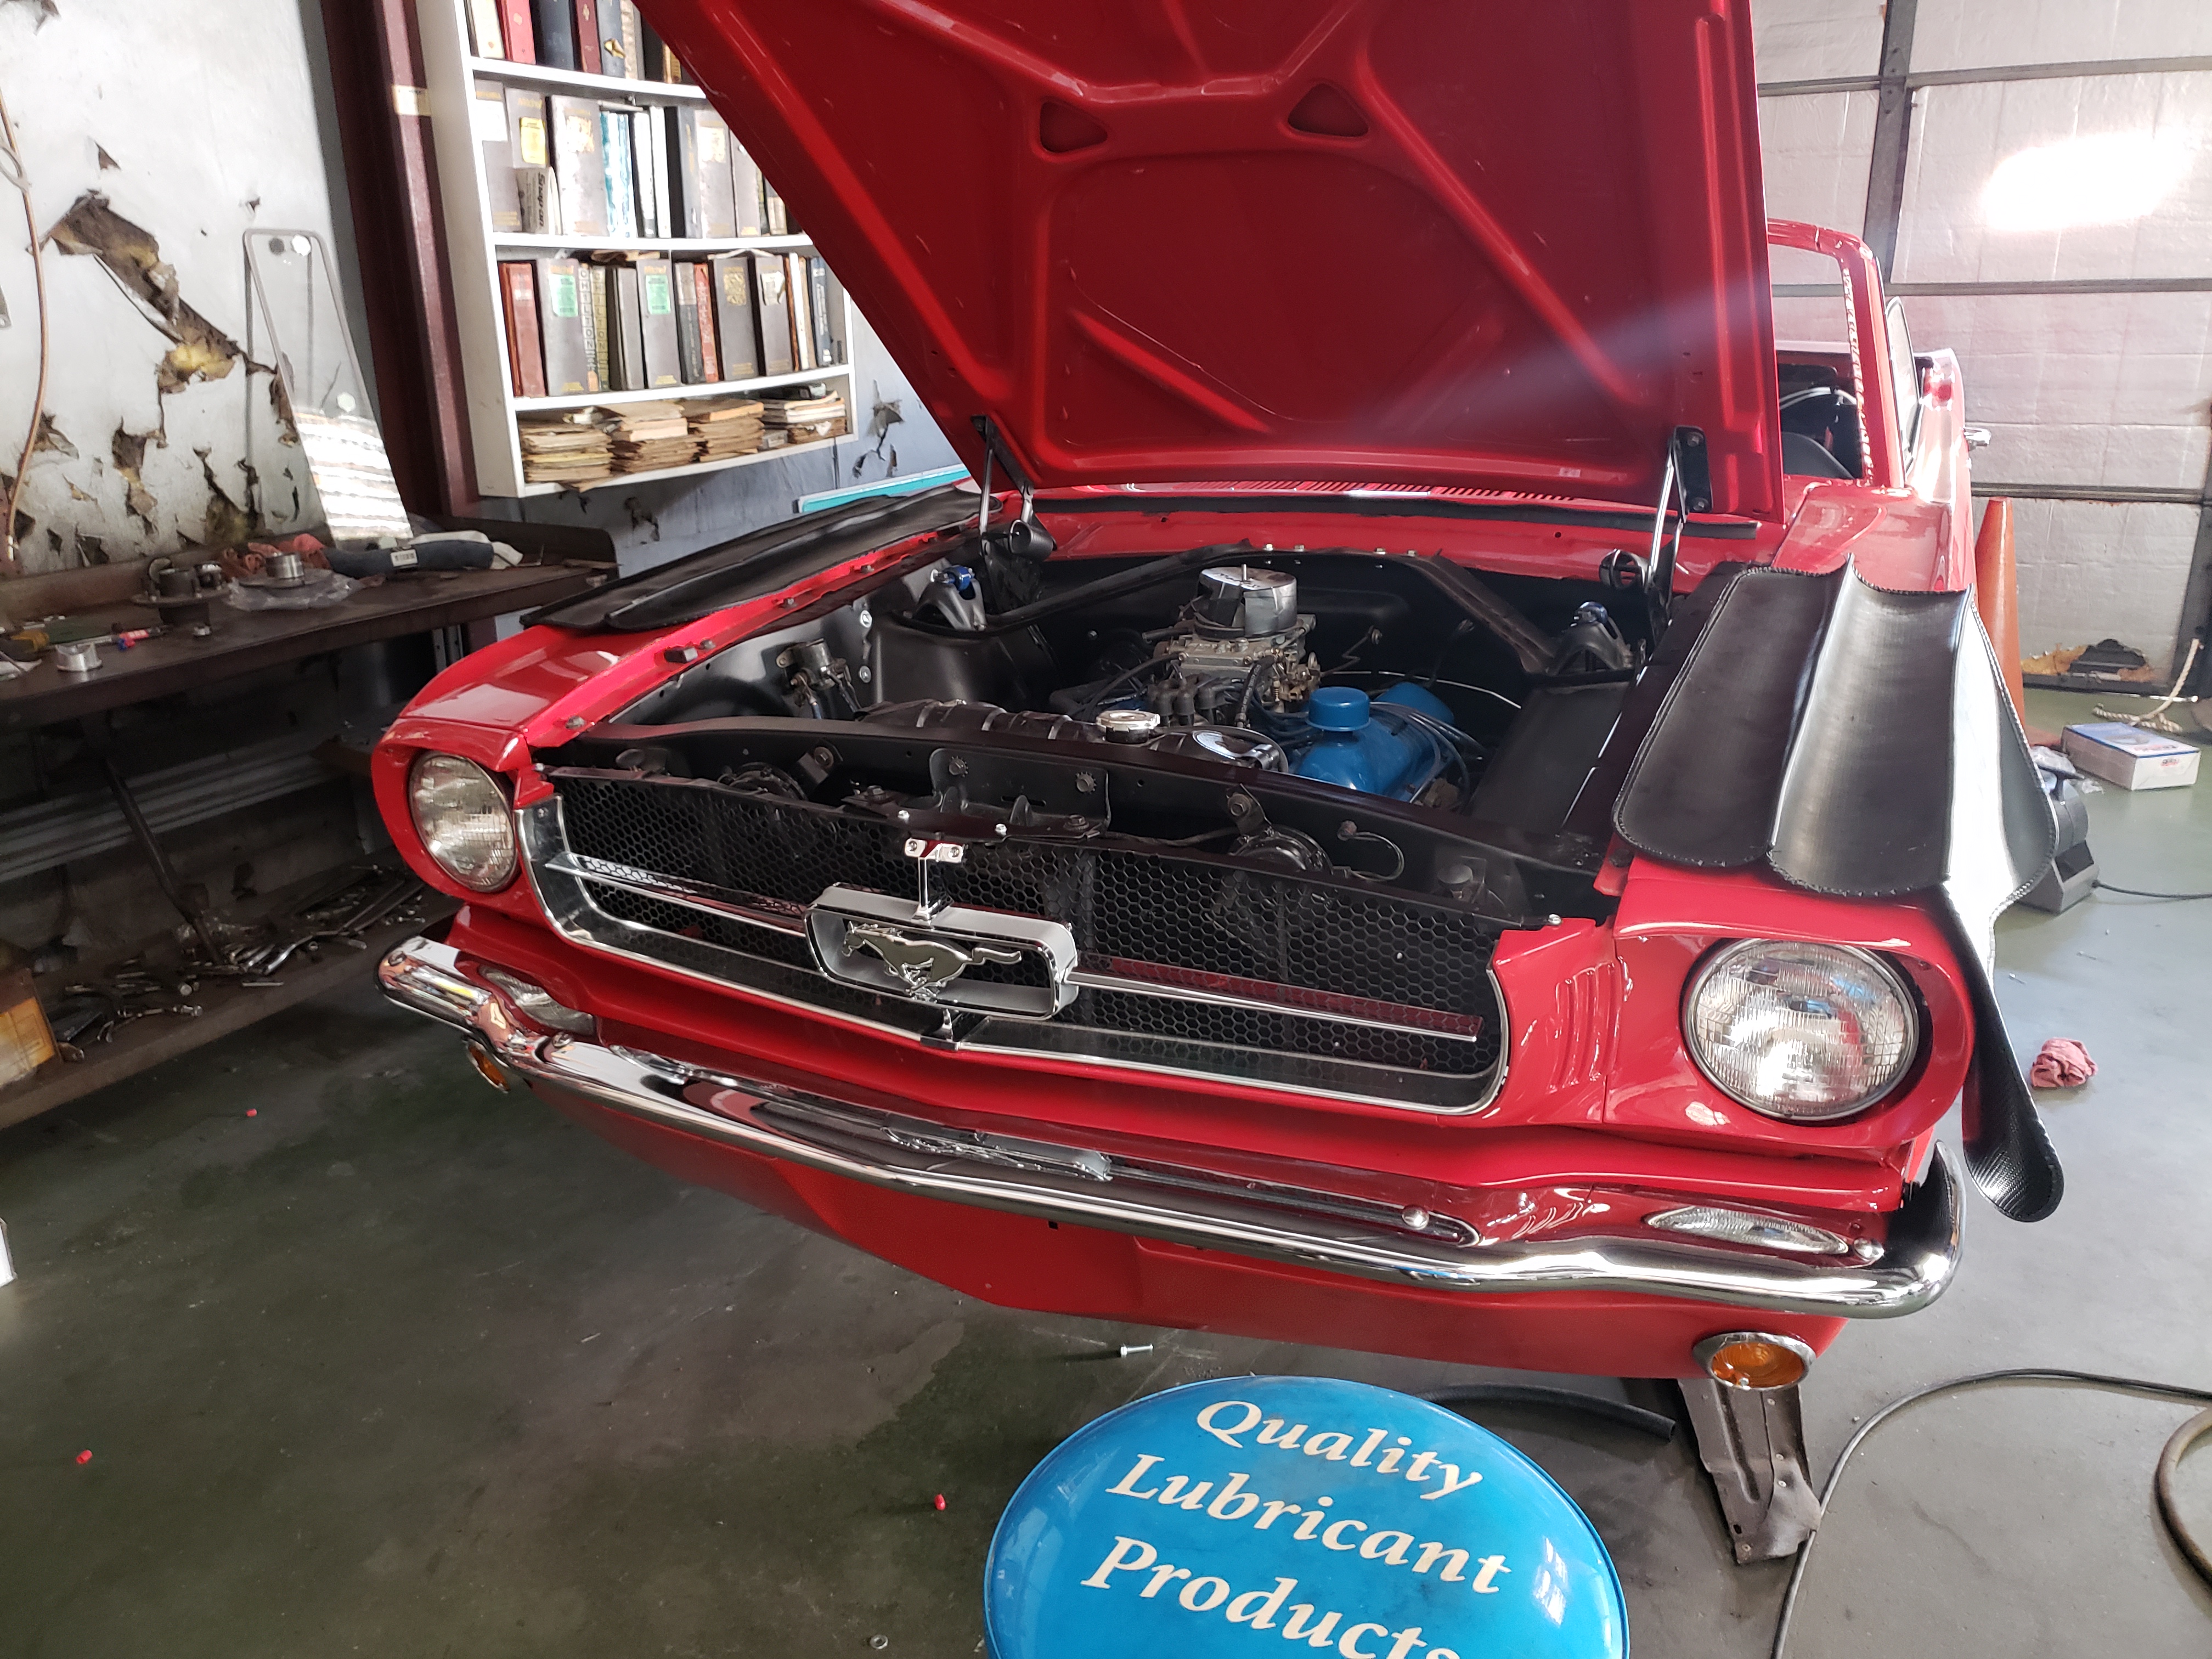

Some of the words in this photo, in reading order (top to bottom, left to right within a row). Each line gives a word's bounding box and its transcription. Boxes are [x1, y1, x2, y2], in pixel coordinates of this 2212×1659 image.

[580, 269, 593, 348] CHILTON
[594, 272, 606, 349] CHILTON
[1196, 1401, 1483, 1500] Quality
[1105, 1454, 1512, 1594] Lubricant
